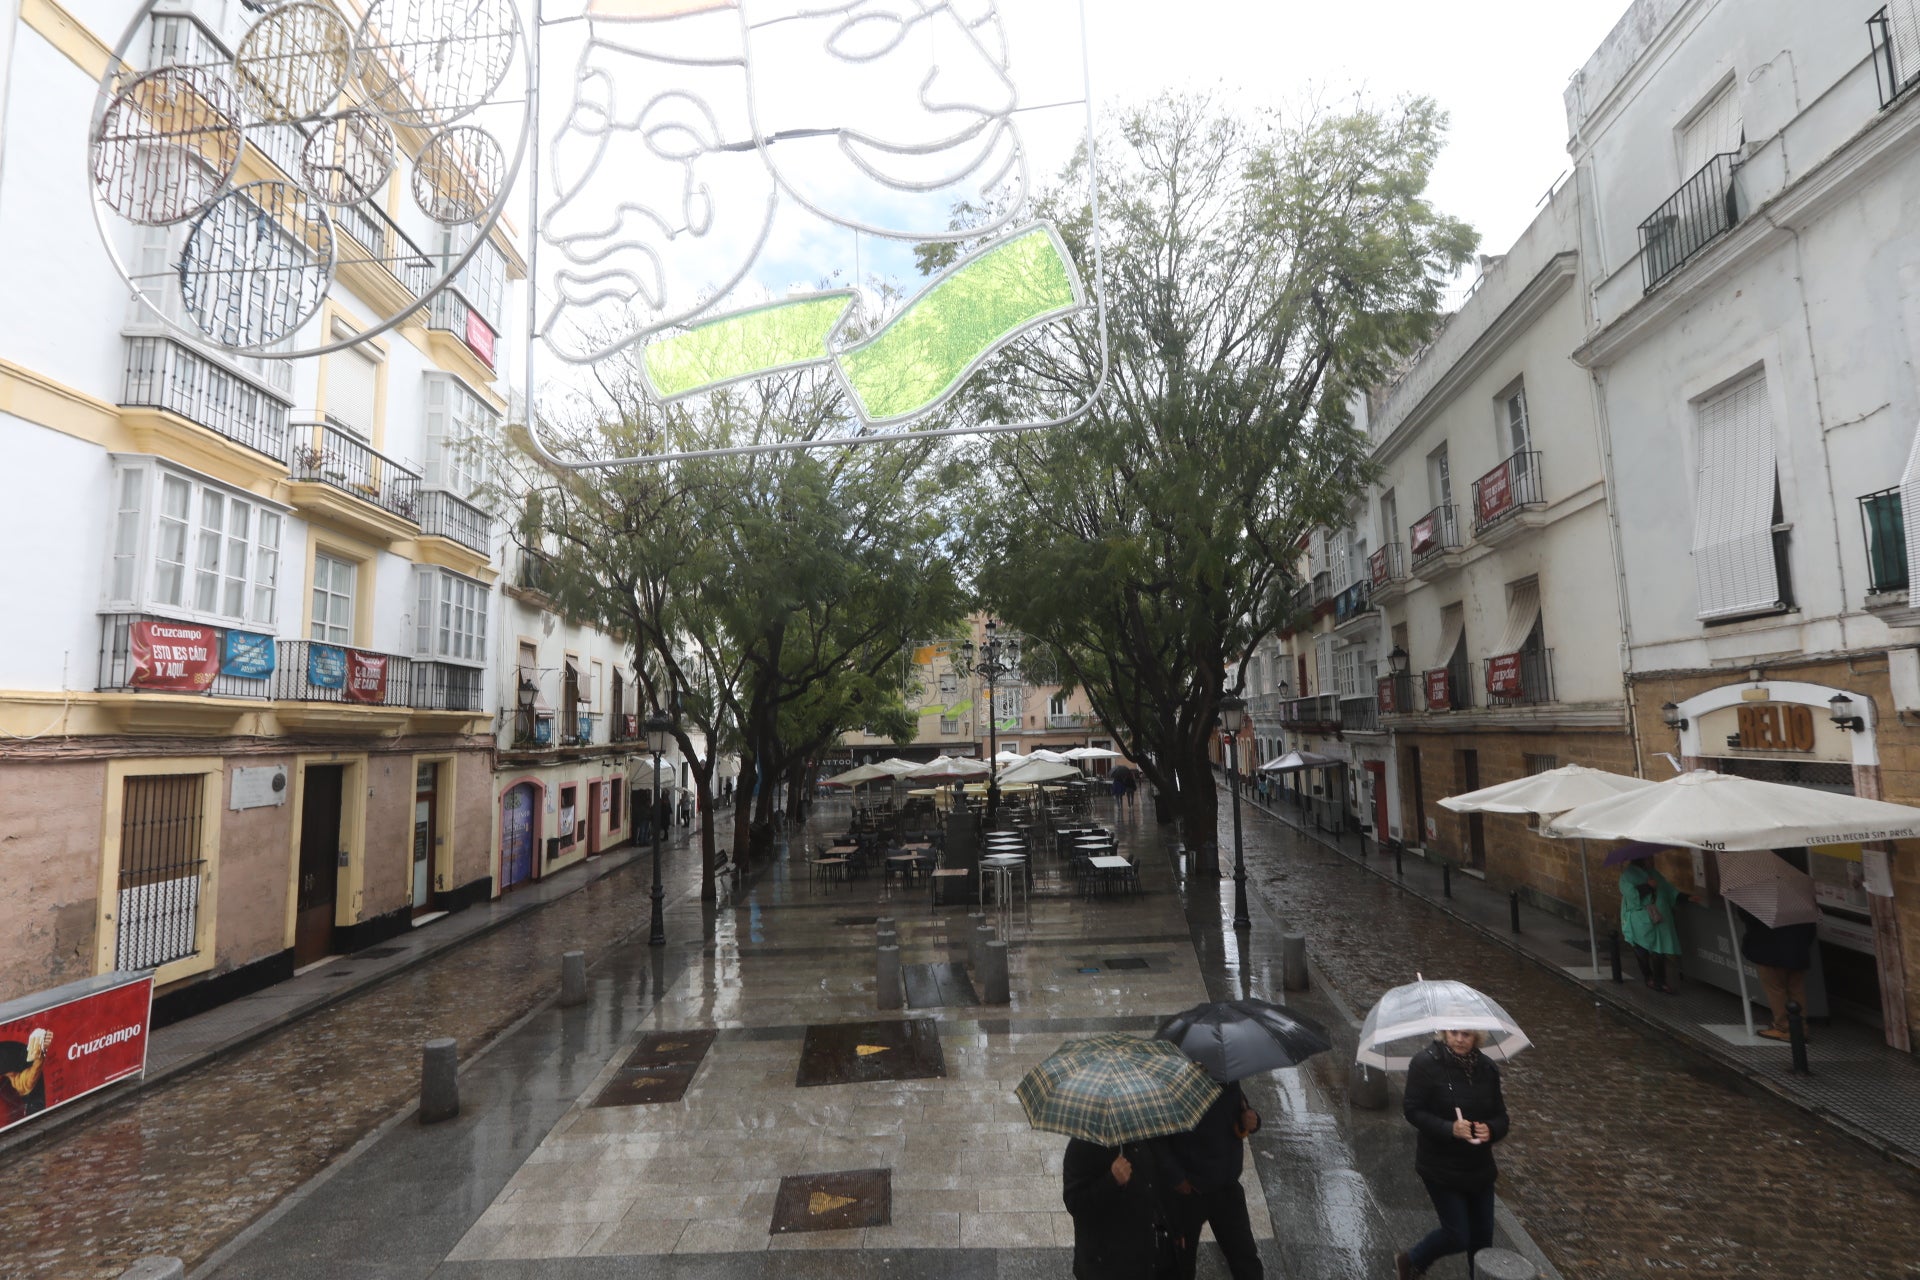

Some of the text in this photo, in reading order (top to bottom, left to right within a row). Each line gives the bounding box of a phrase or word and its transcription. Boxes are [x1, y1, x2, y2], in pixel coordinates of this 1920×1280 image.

[151, 624, 202, 640] Cruzcampo
[152, 644, 171, 660] ESTO
[188, 645, 207, 661] CÁDIZ
[154, 662, 166, 676] Y
[1806, 834, 1841, 845] CERVEZA
[1871, 830, 1886, 839] SIN
[1889, 828, 1914, 838] PRISA
[67, 1022, 141, 1061] Cruzcampo
